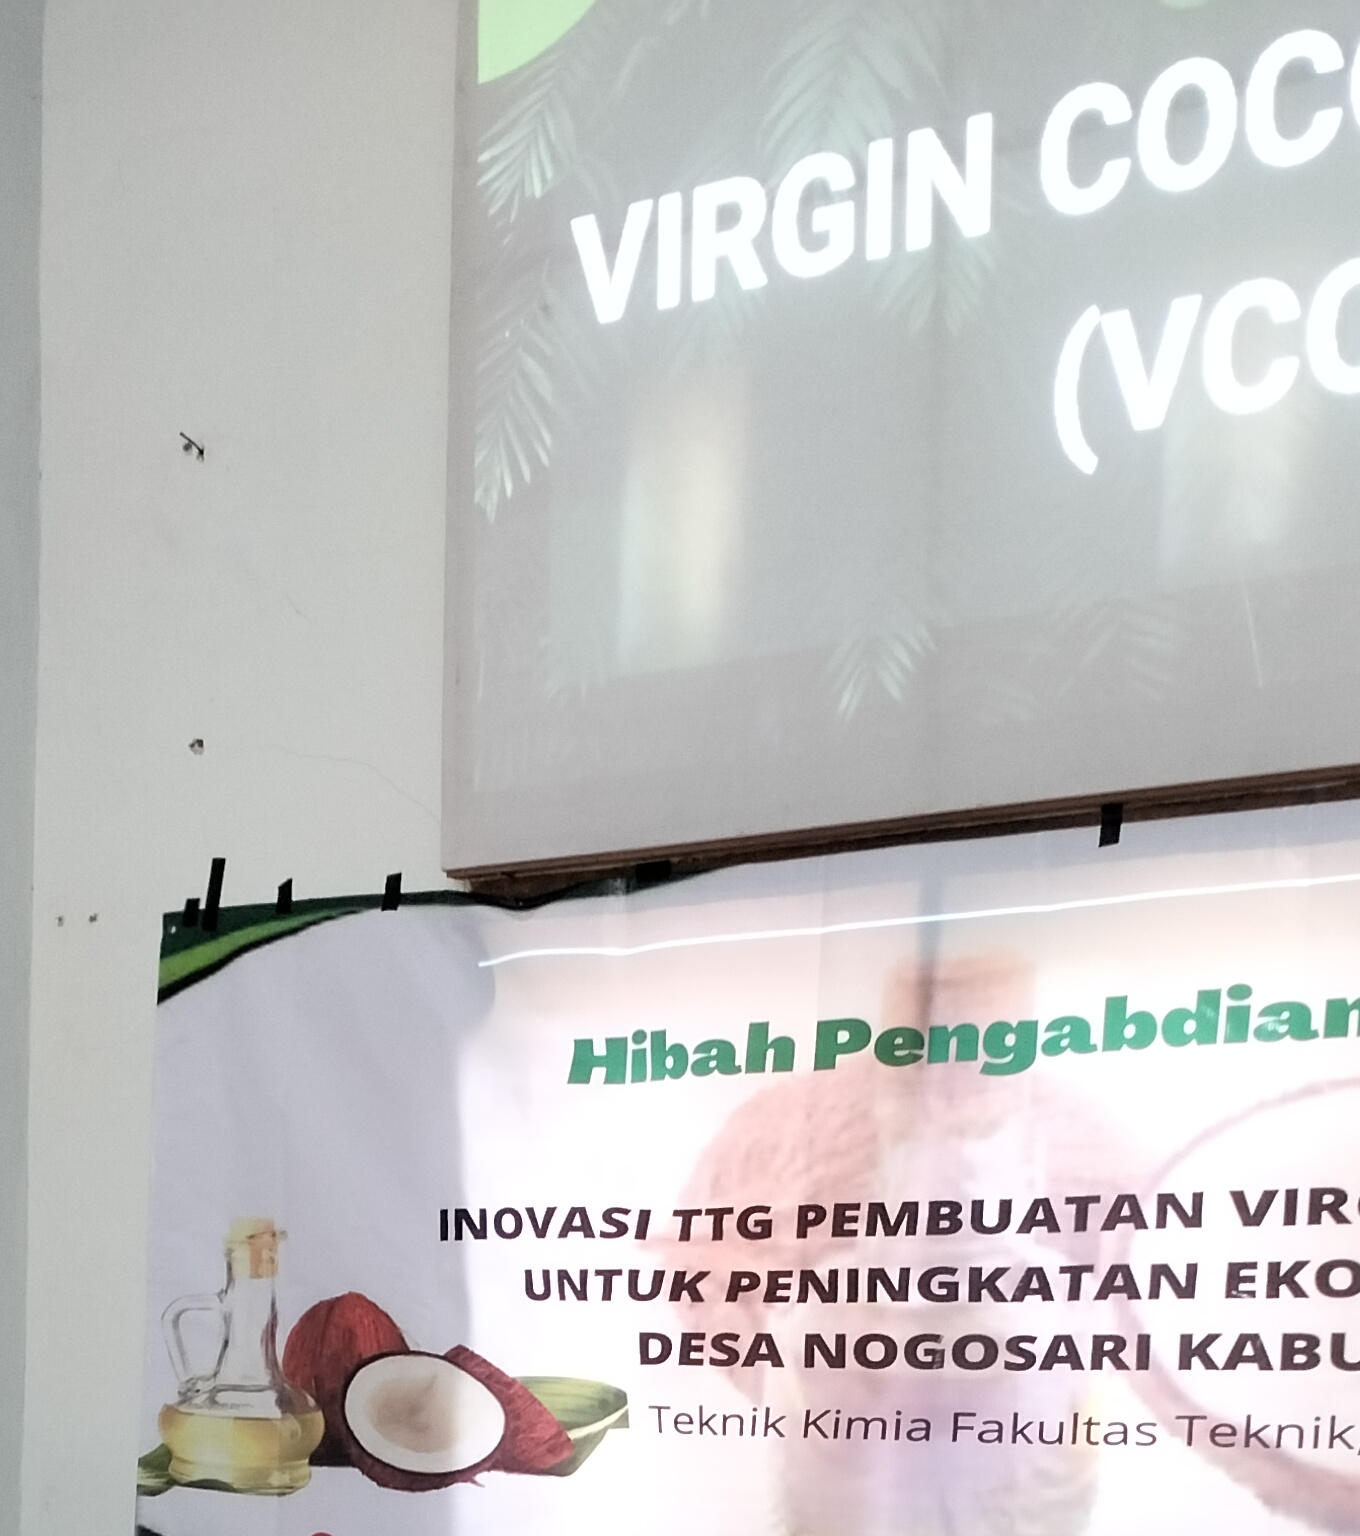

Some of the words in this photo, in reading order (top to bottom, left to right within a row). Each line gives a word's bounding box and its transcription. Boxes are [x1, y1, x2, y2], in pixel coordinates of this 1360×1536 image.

[570, 112, 993, 324] VIRGIN
[566, 1020, 796, 1085] Hibah
[439, 1205, 652, 1242] INOVASI
[671, 1204, 774, 1243] TTG
[795, 1190, 1205, 1240] PEMBUATAN
[523, 1268, 712, 1304] UNTUK
[724, 1256, 1199, 1305] PENINGKATAN
[638, 1331, 785, 1369] DESA
[803, 1332, 1152, 1373] NOGOSARI
[648, 1404, 787, 1439] Teknik
[802, 1408, 932, 1443] Kimia
[951, 1411, 1158, 1447] Fakultas
